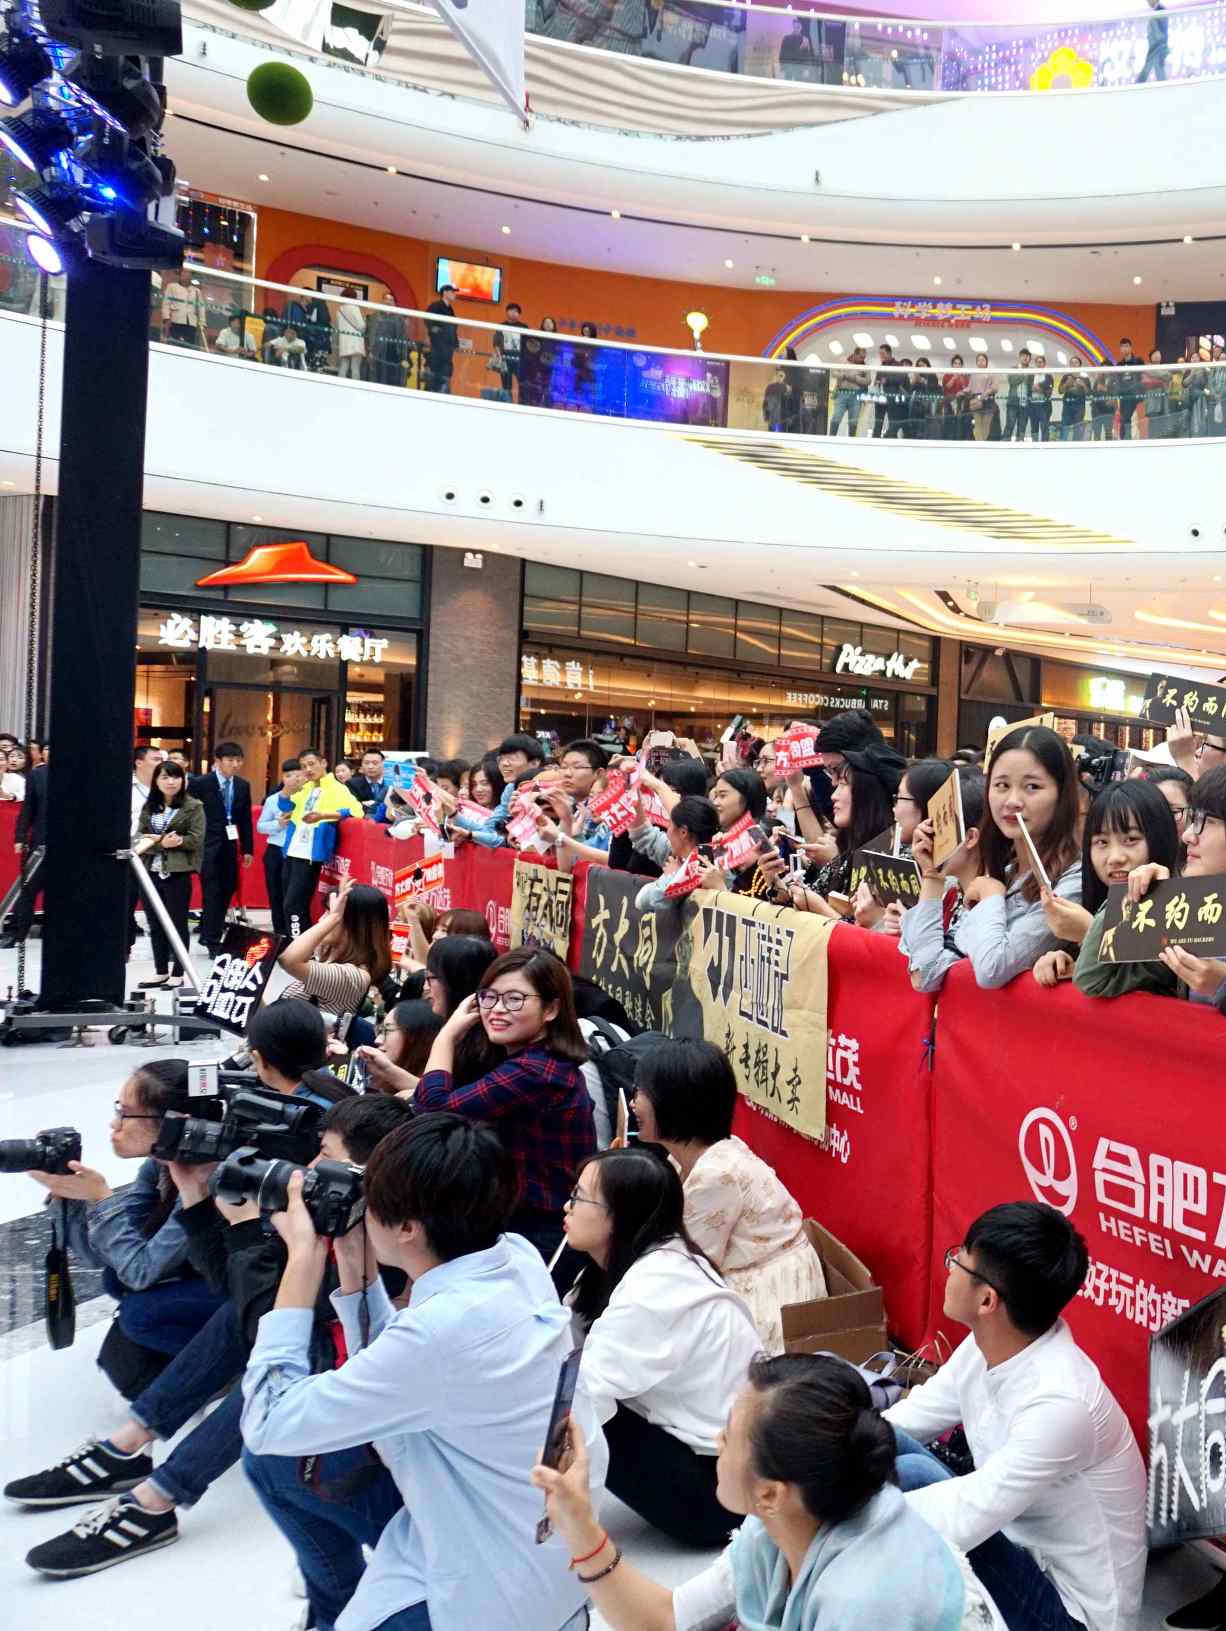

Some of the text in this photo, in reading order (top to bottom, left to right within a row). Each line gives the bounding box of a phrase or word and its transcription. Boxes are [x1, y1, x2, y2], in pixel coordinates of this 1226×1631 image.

[159, 612, 389, 663] 必胜客 欢乐餐厅
[836, 643, 921, 680] Pizza Hut
[591, 893, 659, 992] 方大同
[828, 1085, 864, 1114] MALL
[1099, 1212, 1174, 1260] HEFEI
